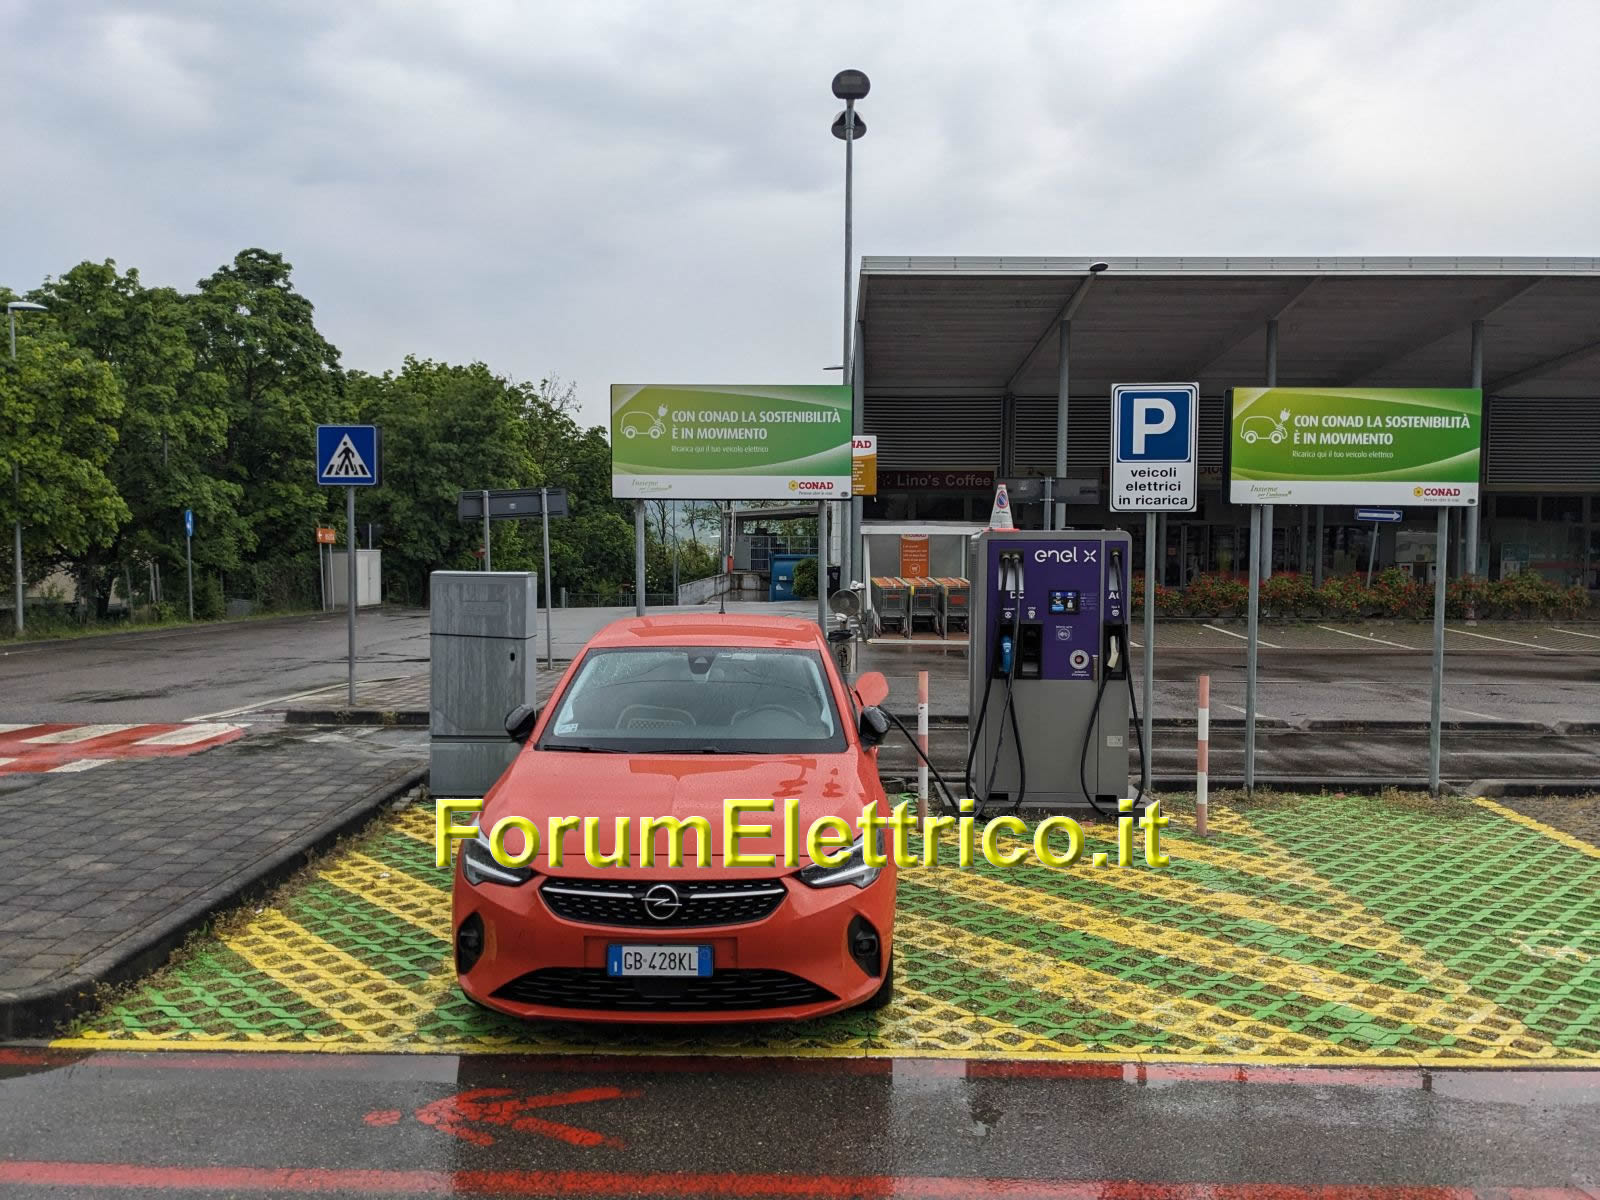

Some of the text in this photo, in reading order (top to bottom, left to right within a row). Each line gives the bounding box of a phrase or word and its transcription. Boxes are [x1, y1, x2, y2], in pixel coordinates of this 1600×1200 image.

[672, 408, 841, 423] CON CONAD LA SOSTENIBILITÀ
[1294, 413, 1470, 429] CON CONAD LA SOSTENIBILITÀ
[1133, 398, 1176, 454] P
[672, 425, 768, 439] È IN MOVIMENTO
[1294, 430, 1393, 445] È IN MOVIMENTO
[744, 445, 769, 453] elettrico
[1292, 450, 1315, 458] Ricarica
[1317, 451, 1327, 459] qui
[1345, 450, 1367, 458] veicolo
[1368, 451, 1394, 459] elettrico
[1130, 467, 1177, 477] veicoli
[798, 481, 834, 490] CONAD
[897, 474, 992, 487] Lino's Coffee
[1126, 481, 1181, 491] elettrici
[1423, 488, 1461, 497] CONAD
[1119, 495, 1188, 505] in ricarica
[1034, 546, 1078, 563] enel
